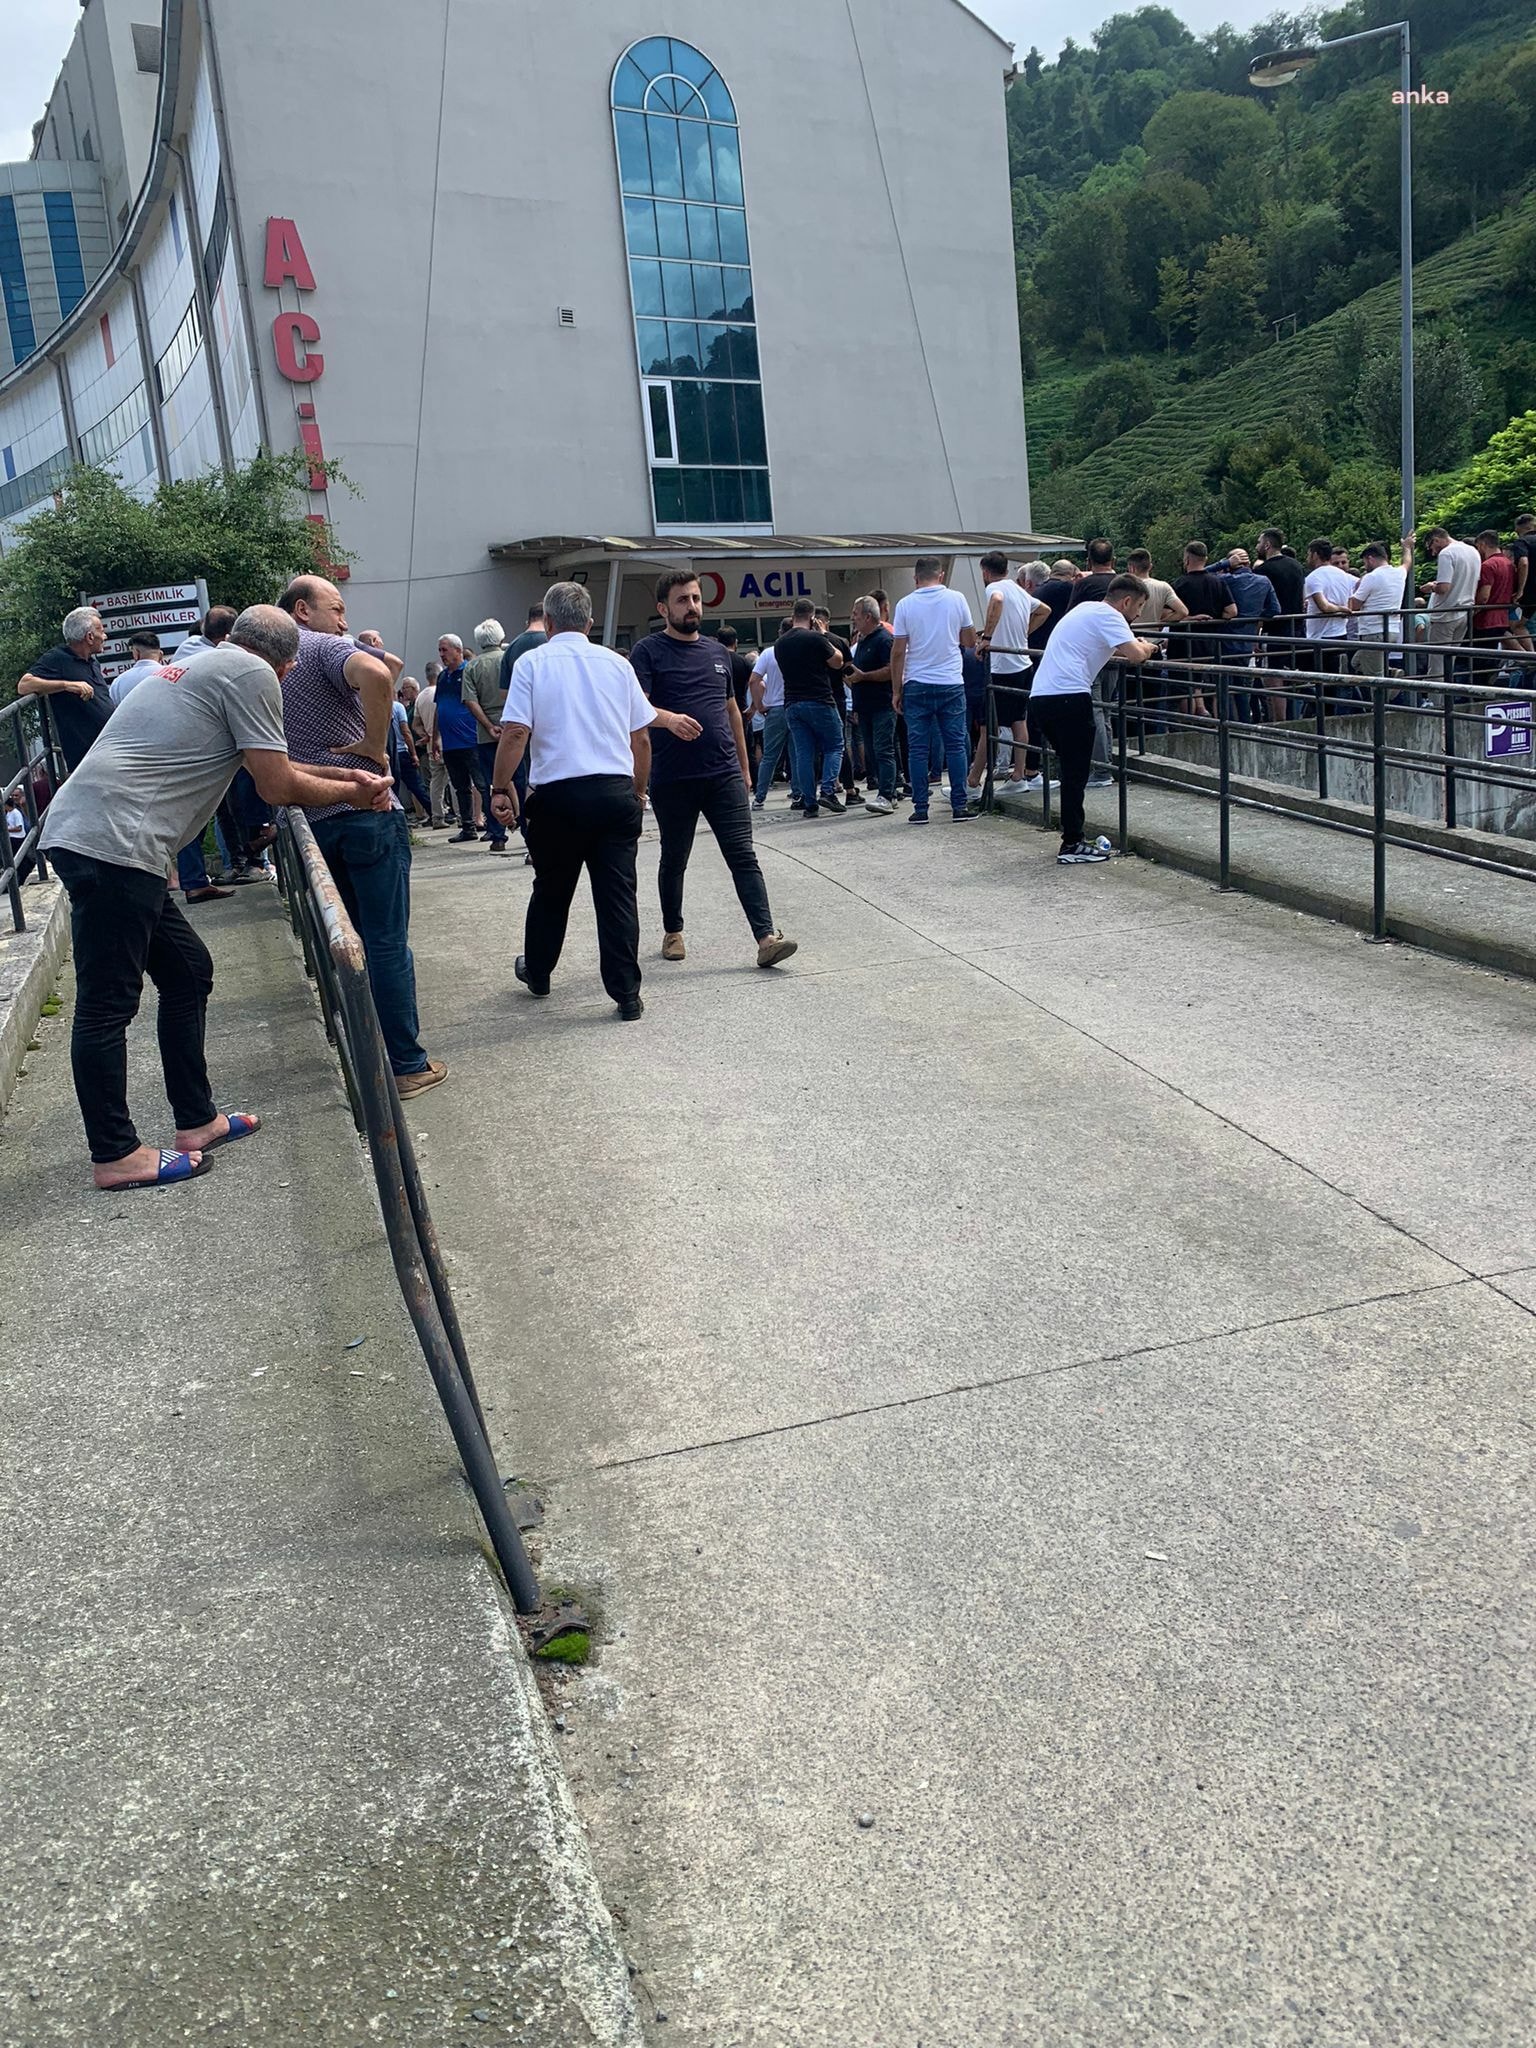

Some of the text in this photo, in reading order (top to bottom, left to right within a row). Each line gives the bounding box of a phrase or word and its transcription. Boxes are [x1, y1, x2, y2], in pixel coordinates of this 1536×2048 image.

[739, 571, 812, 598] ACIL
[106, 587, 185, 607] BAŞHEKİMLİK
[110, 611, 196, 630] POLİKLİNİKLER
